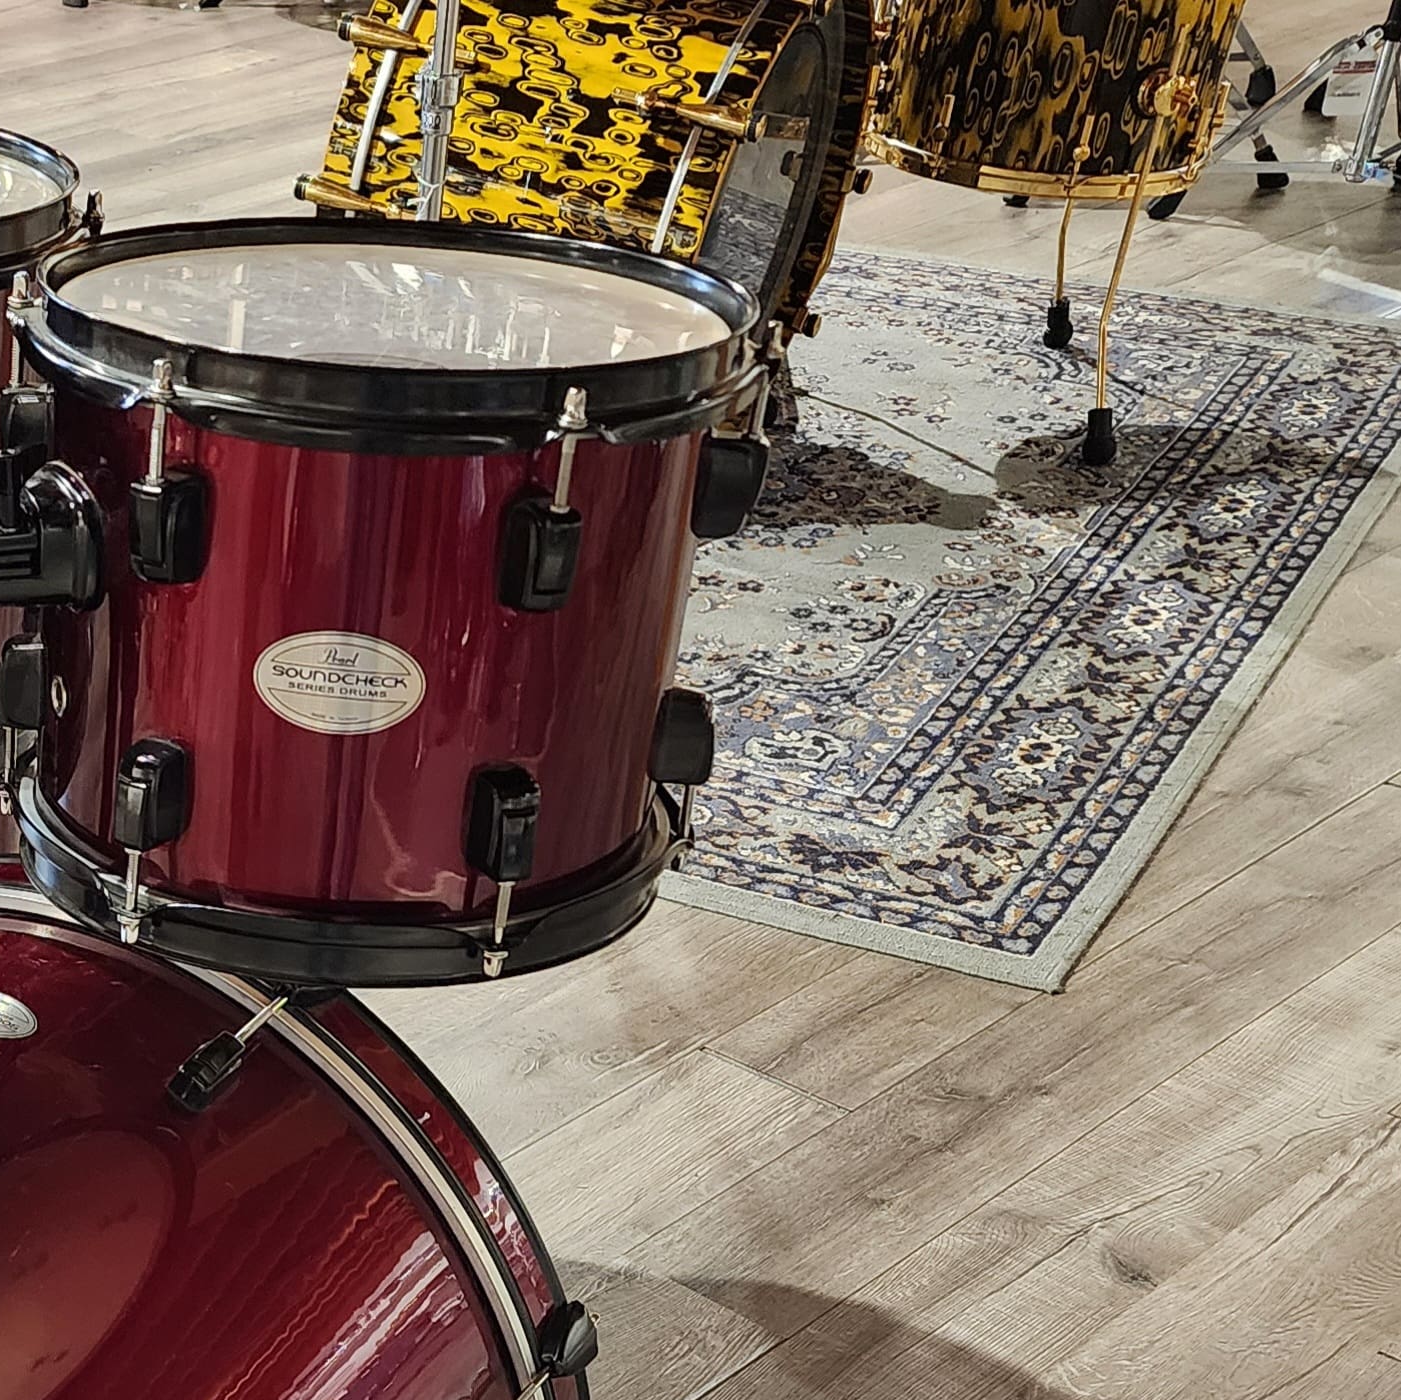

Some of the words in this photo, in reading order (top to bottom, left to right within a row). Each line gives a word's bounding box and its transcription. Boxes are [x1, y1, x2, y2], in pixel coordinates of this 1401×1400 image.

[321, 647, 360, 666] Pearl
[271, 664, 408, 689] SOUNDCHECK
[287, 681, 335, 695] SERIES
[339, 687, 388, 699] DRUMS
